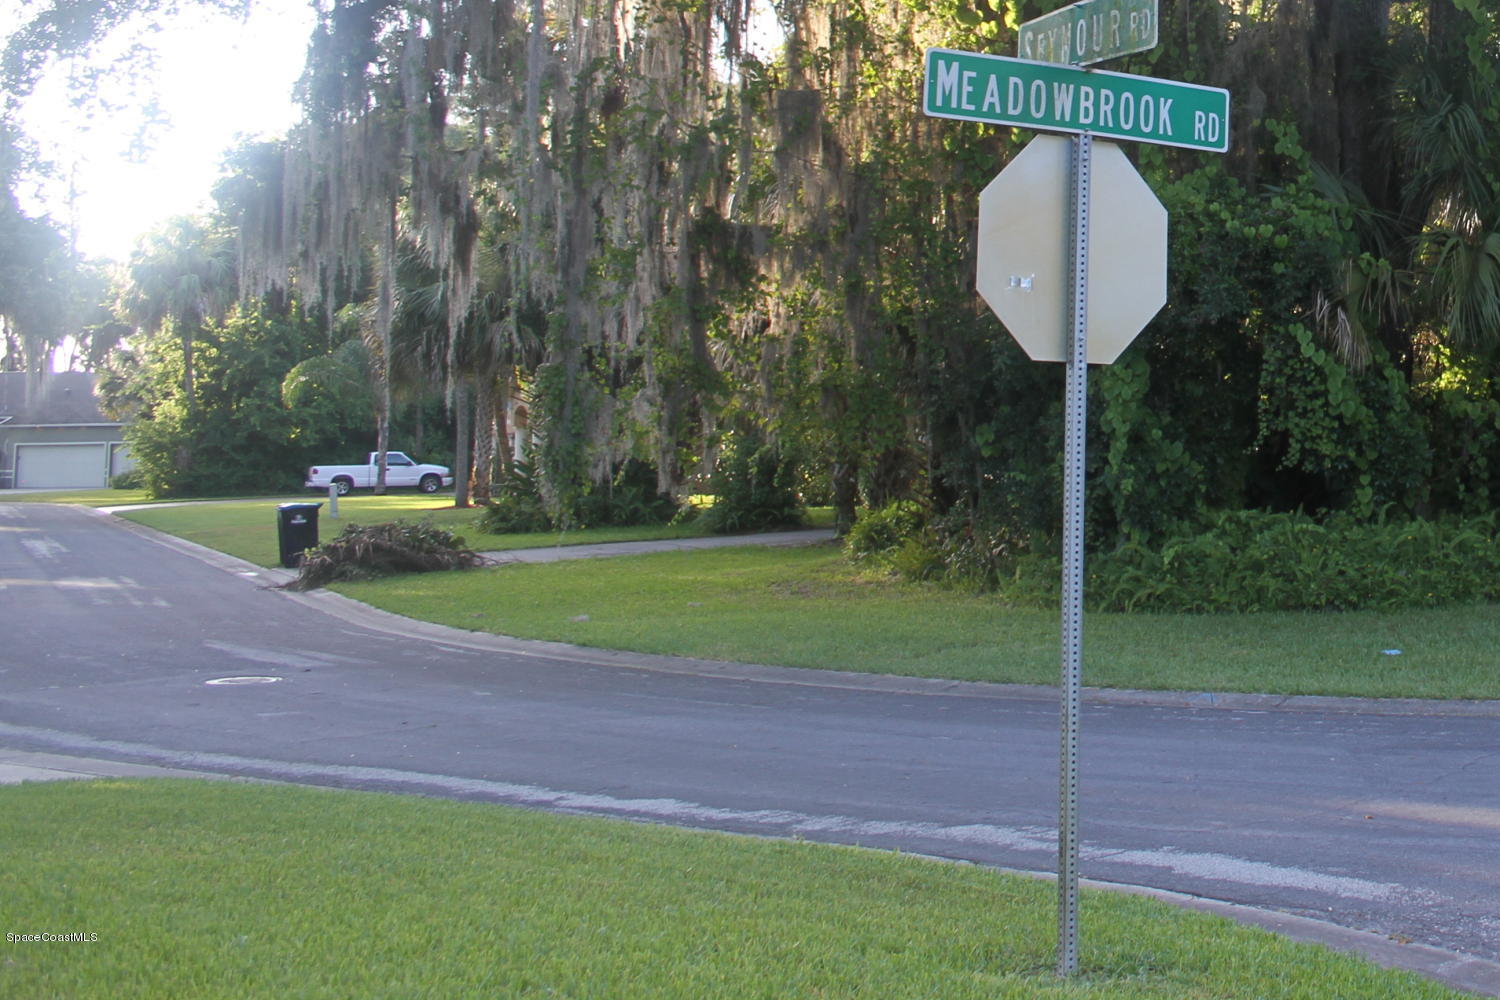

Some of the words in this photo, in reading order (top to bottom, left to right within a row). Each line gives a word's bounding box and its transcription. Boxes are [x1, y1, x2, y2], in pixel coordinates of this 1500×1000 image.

[1024, 9, 1120, 64] SEYMOUR
[1130, 9, 1151, 41] RD
[936, 59, 1173, 136] MEADOWBROOK
[1194, 110, 1219, 143] RD
